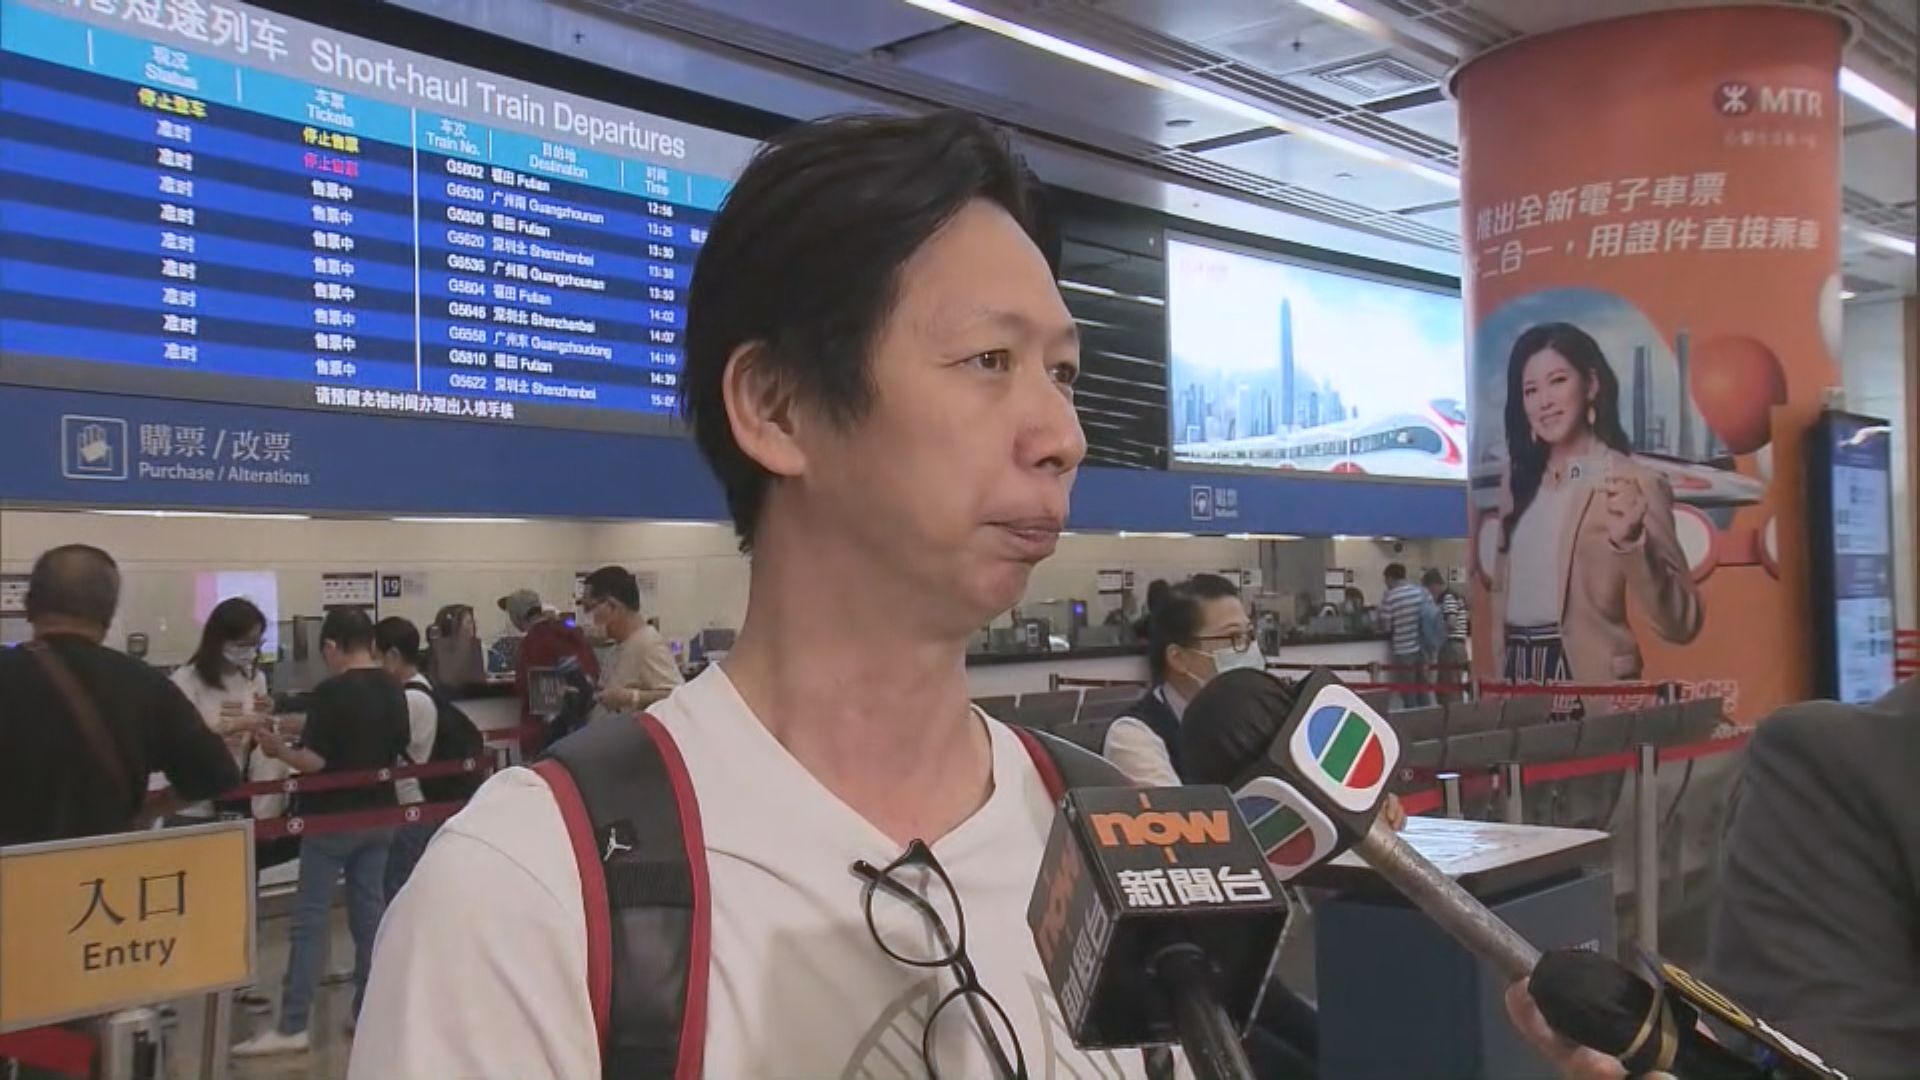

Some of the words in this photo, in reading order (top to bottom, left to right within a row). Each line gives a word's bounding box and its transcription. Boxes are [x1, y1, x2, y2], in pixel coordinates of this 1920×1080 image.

[305, 102, 355, 128] Tickets
[310, 39, 468, 108] Short-haul
[476, 81, 545, 126] Train
[553, 102, 686, 160] Departures
[1759, 85, 1822, 117] MTR
[426, 132, 458, 149] Train
[459, 139, 480, 156] No.
[542, 142, 576, 163] 目的地
[529, 155, 588, 178] Destination
[645, 180, 669, 196] Time
[1474, 215, 1820, 279] 二合一，用證件直接乘車
[139, 423, 206, 458] 購票
[212, 429, 227, 461] /
[231, 429, 292, 463] 改票
[139, 461, 214, 482] Purchase
[217, 465, 225, 482] /
[228, 466, 311, 487] Alterations
[383, 579, 399, 594] 19
[1090, 808, 1231, 847] now
[1116, 864, 1273, 907] 新聞台
[67, 869, 187, 935] 入口
[83, 937, 177, 972] Entry
